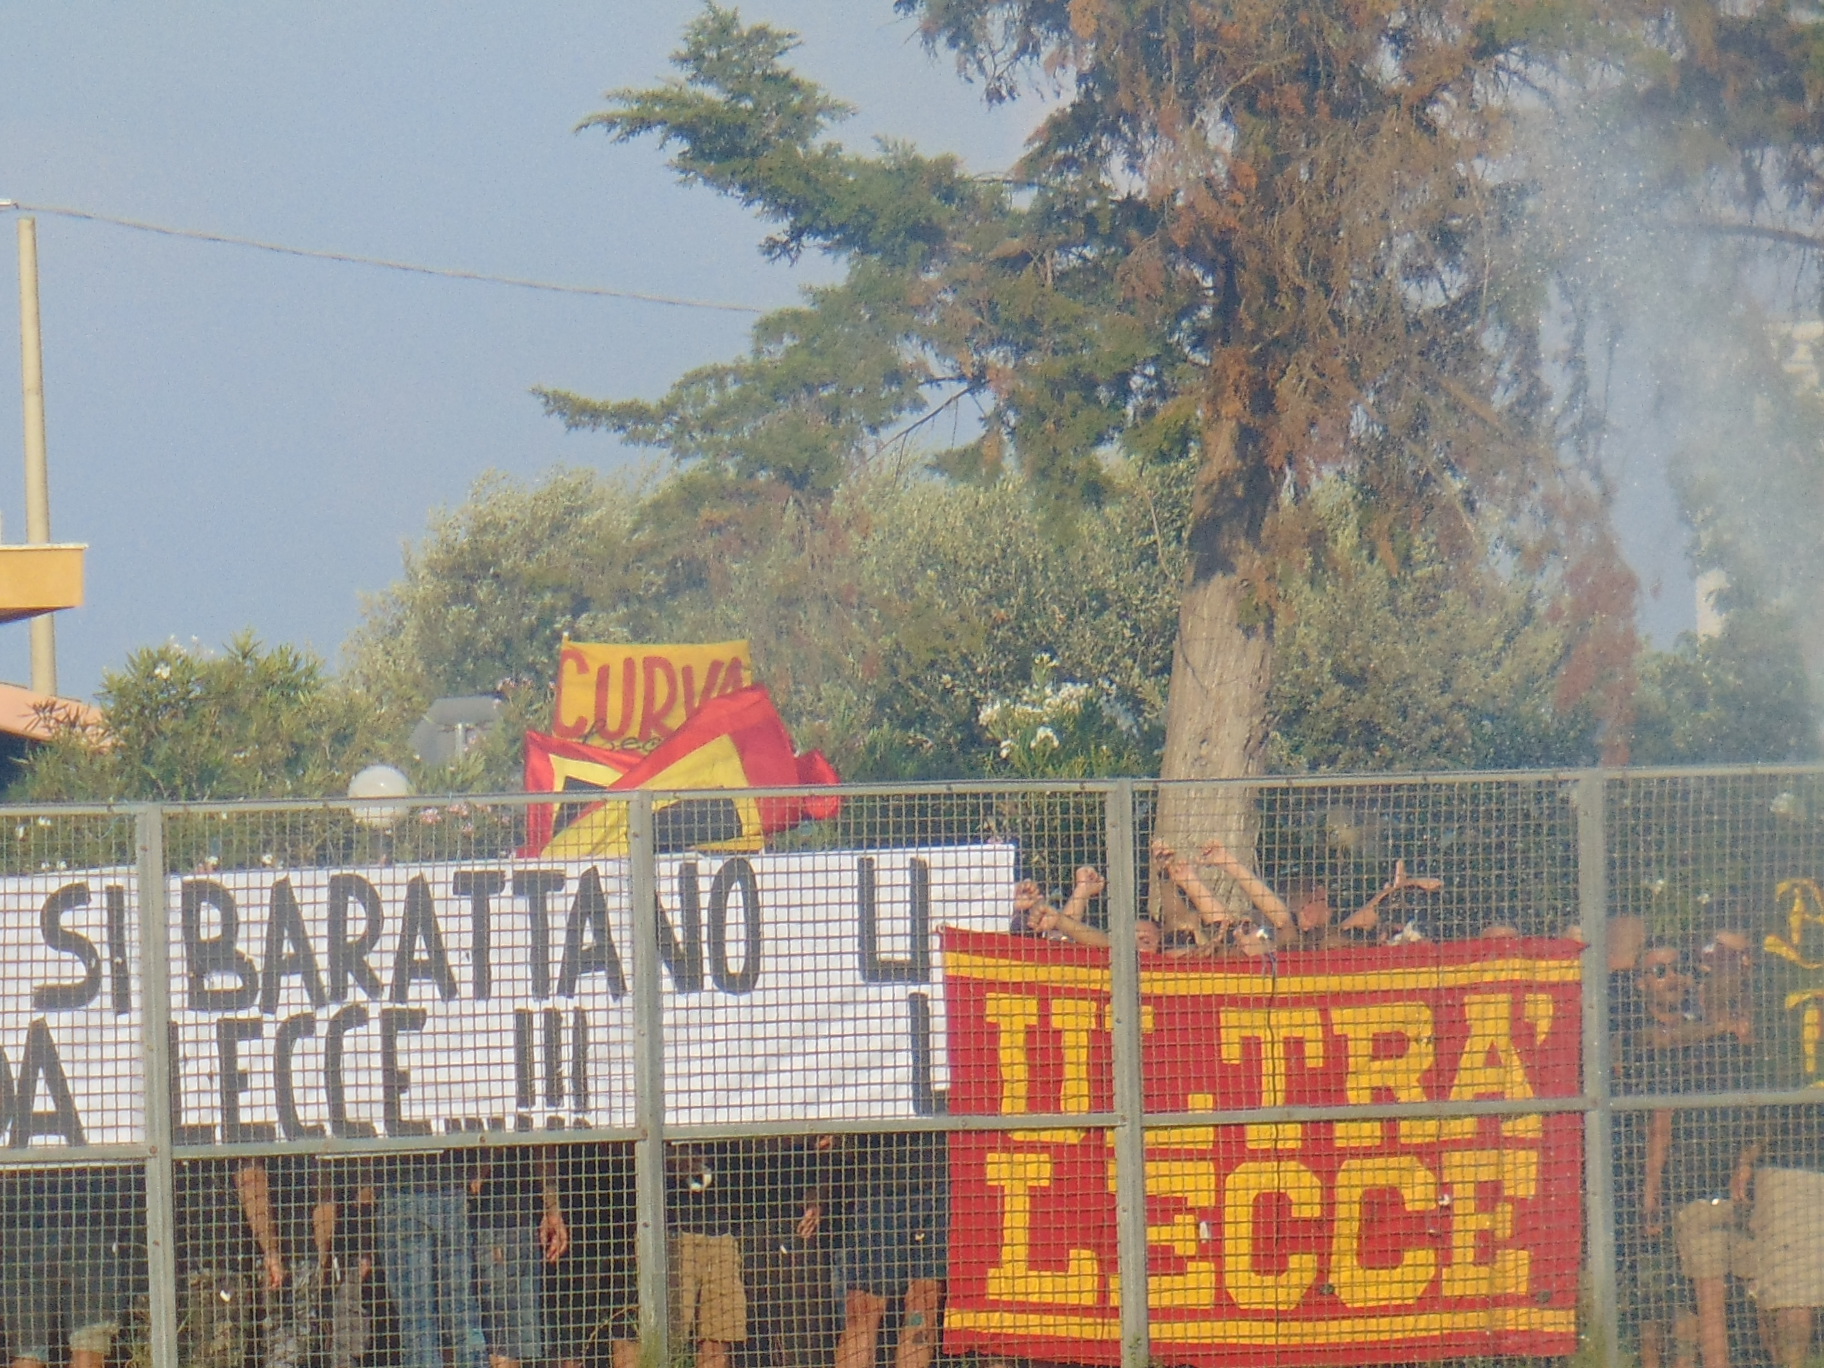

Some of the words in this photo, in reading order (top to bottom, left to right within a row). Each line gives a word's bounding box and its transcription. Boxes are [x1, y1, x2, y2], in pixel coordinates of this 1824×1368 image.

[32, 881, 132, 1015] SI
[181, 857, 760, 1013] BARATTANO
[985, 1149, 1538, 1310] LECCE
